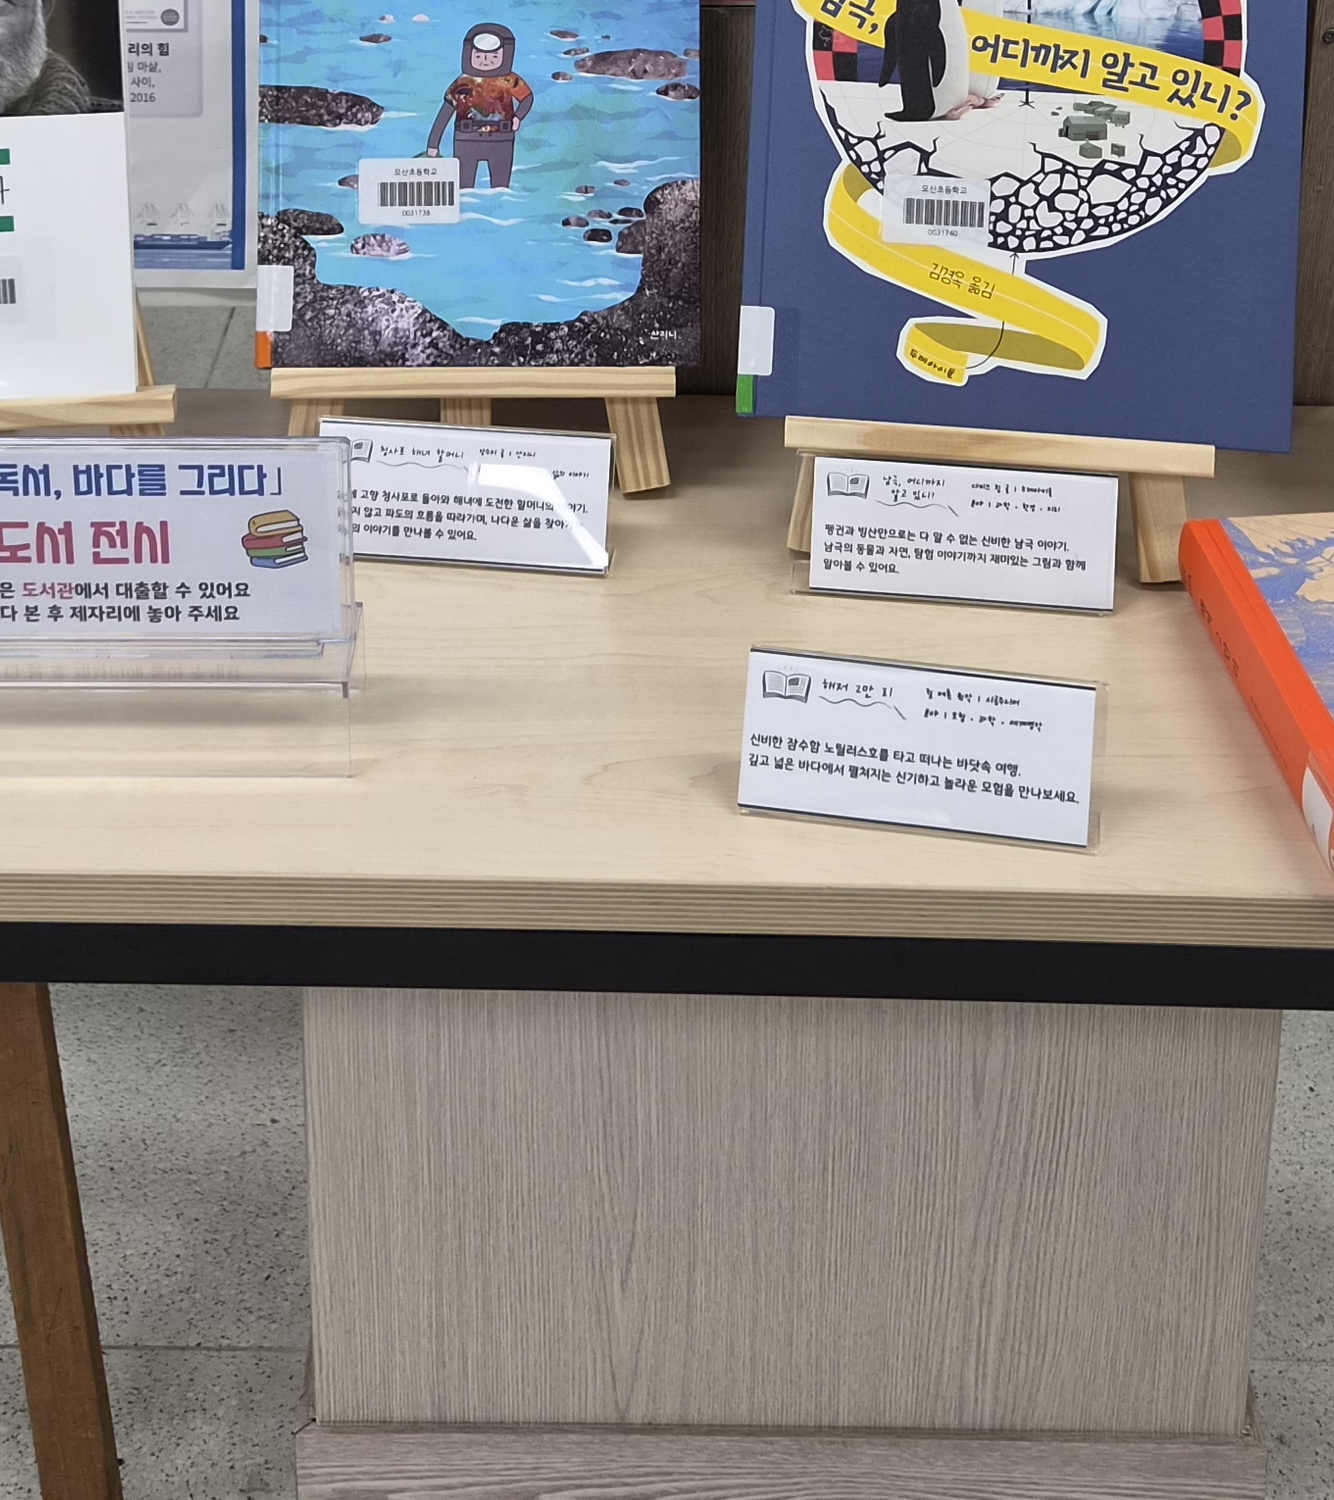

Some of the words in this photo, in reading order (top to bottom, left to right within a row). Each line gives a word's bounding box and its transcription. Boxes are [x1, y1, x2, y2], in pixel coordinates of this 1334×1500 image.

[971, 33, 1090, 78] 어디까지
[1101, 50, 1160, 92] 알고
[1166, 68, 1253, 121] 있니?
[73, 463, 166, 497] 바다를
[178, 463, 283, 497] 그리다」
[91, 520, 170, 565] 전시
[22, 580, 109, 599] 도서관에서
[116, 580, 169, 599] 대출할
[175, 581, 192, 599] 수
[198, 581, 251, 599] 있어요
[1, 604, 18, 622] 다
[24, 604, 41, 622] 본
[47, 603, 63, 622] 후
[69, 604, 141, 623] 제자리에
[147, 604, 181, 622] 놓아
[188, 604, 239, 622] 주세요
[750, 732, 783, 750] 신비한
[787, 736, 820, 754] 잠수함
[824, 740, 889, 762] 노틸러스호를
[893, 748, 915, 764] 타고
[919, 749, 952, 769] 떠나는
[956, 756, 991, 775] 바닷속
[994, 760, 1021, 778] 여행.
